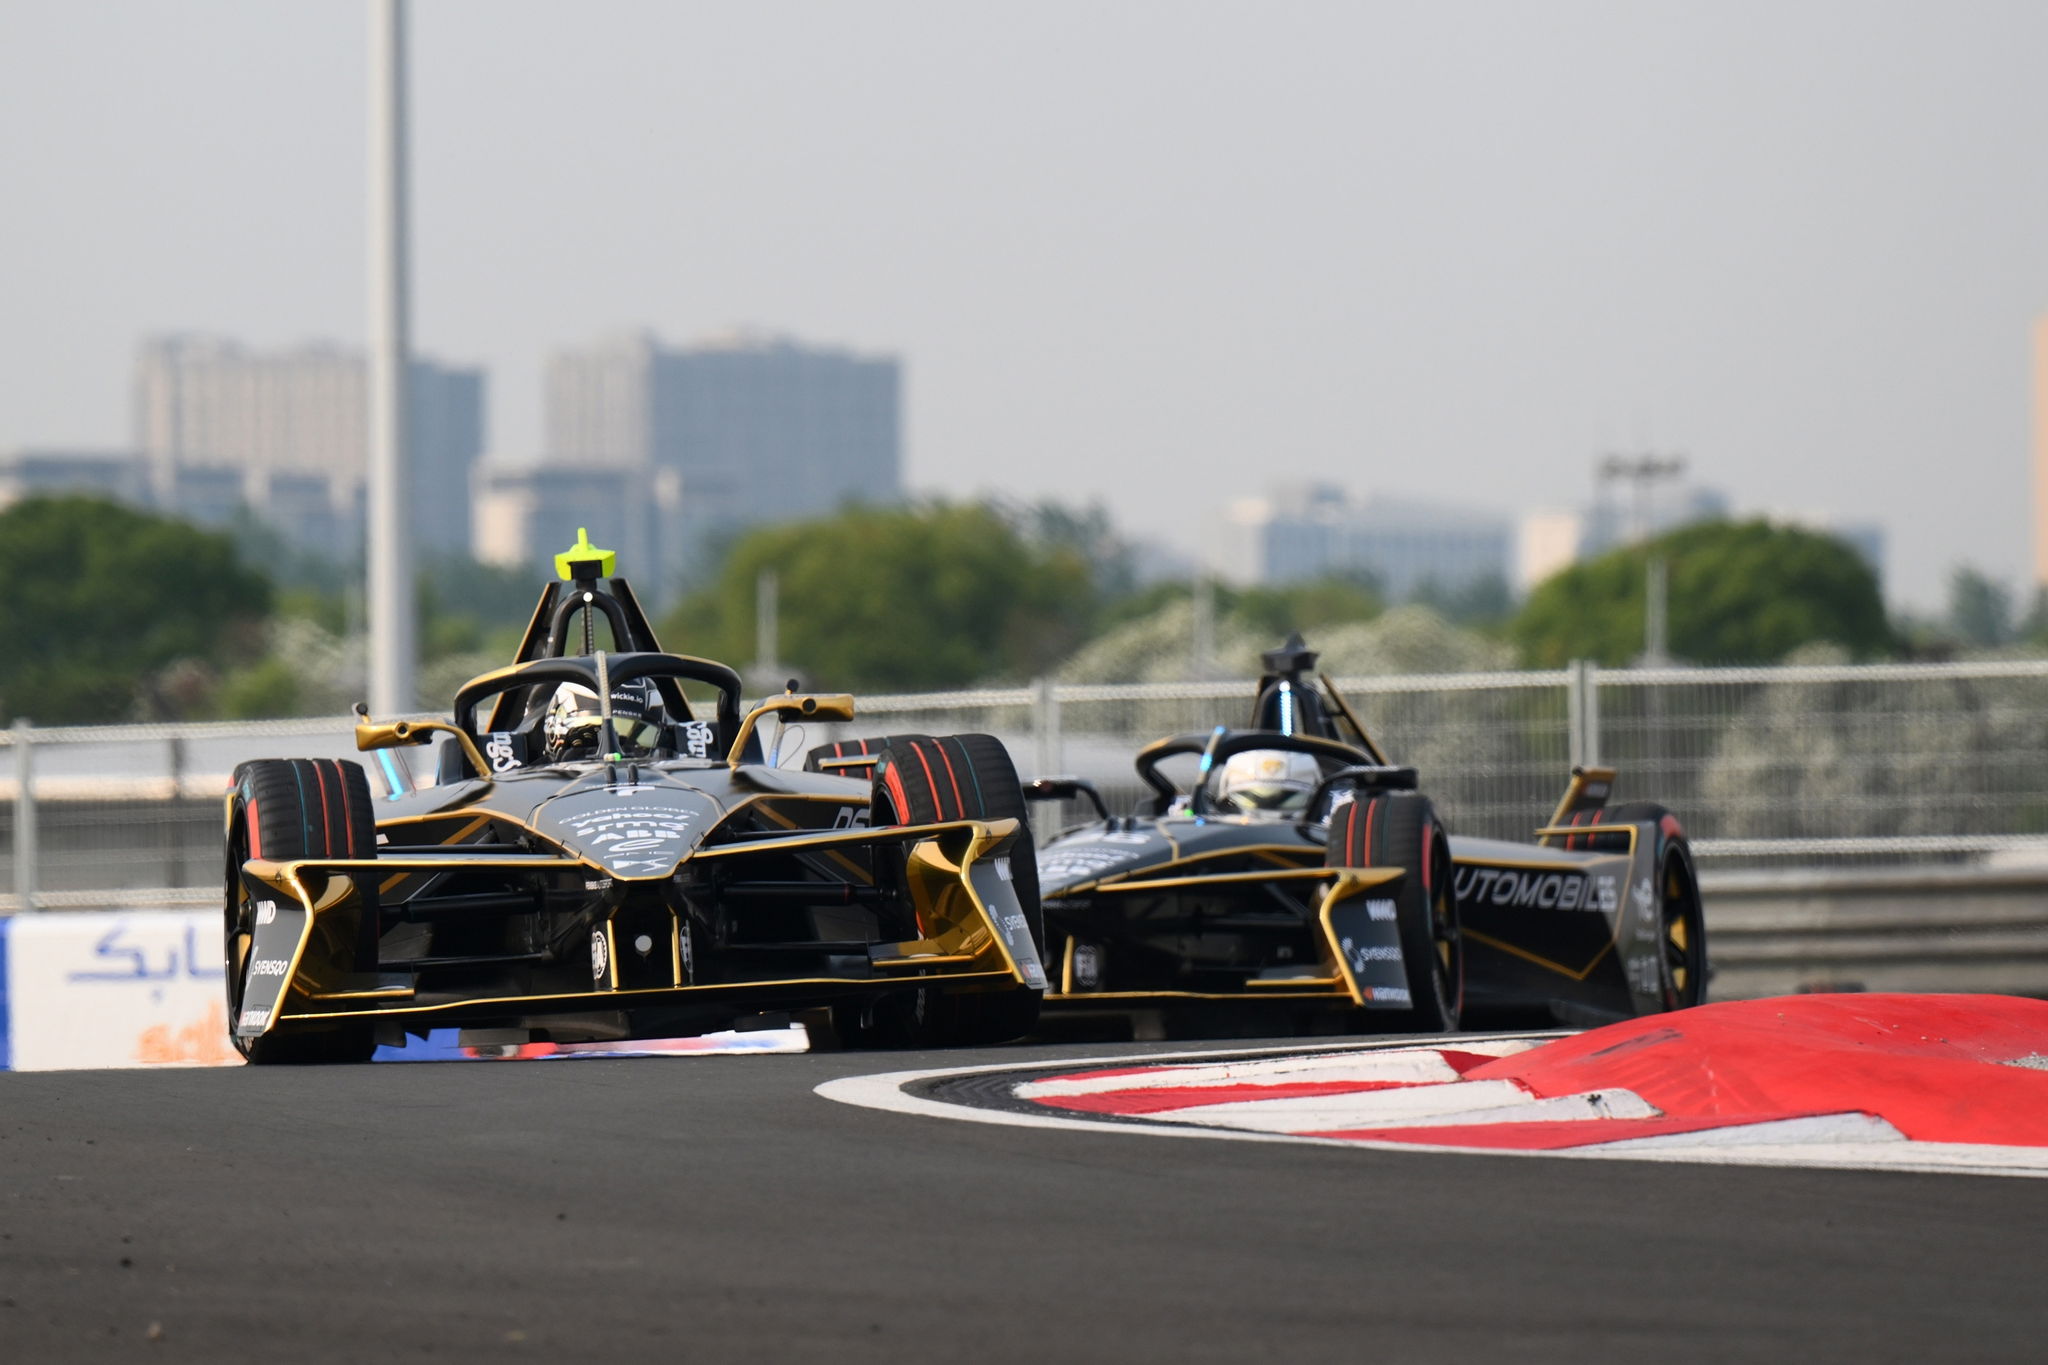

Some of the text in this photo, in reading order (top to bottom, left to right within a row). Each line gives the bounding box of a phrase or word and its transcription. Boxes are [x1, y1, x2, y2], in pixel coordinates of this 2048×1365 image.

[570, 812, 691, 828] yahoo!
[591, 829, 681, 846] ABB
[1454, 867, 1618, 912] UTOMOBILES
[67, 915, 226, 1006] ابك
